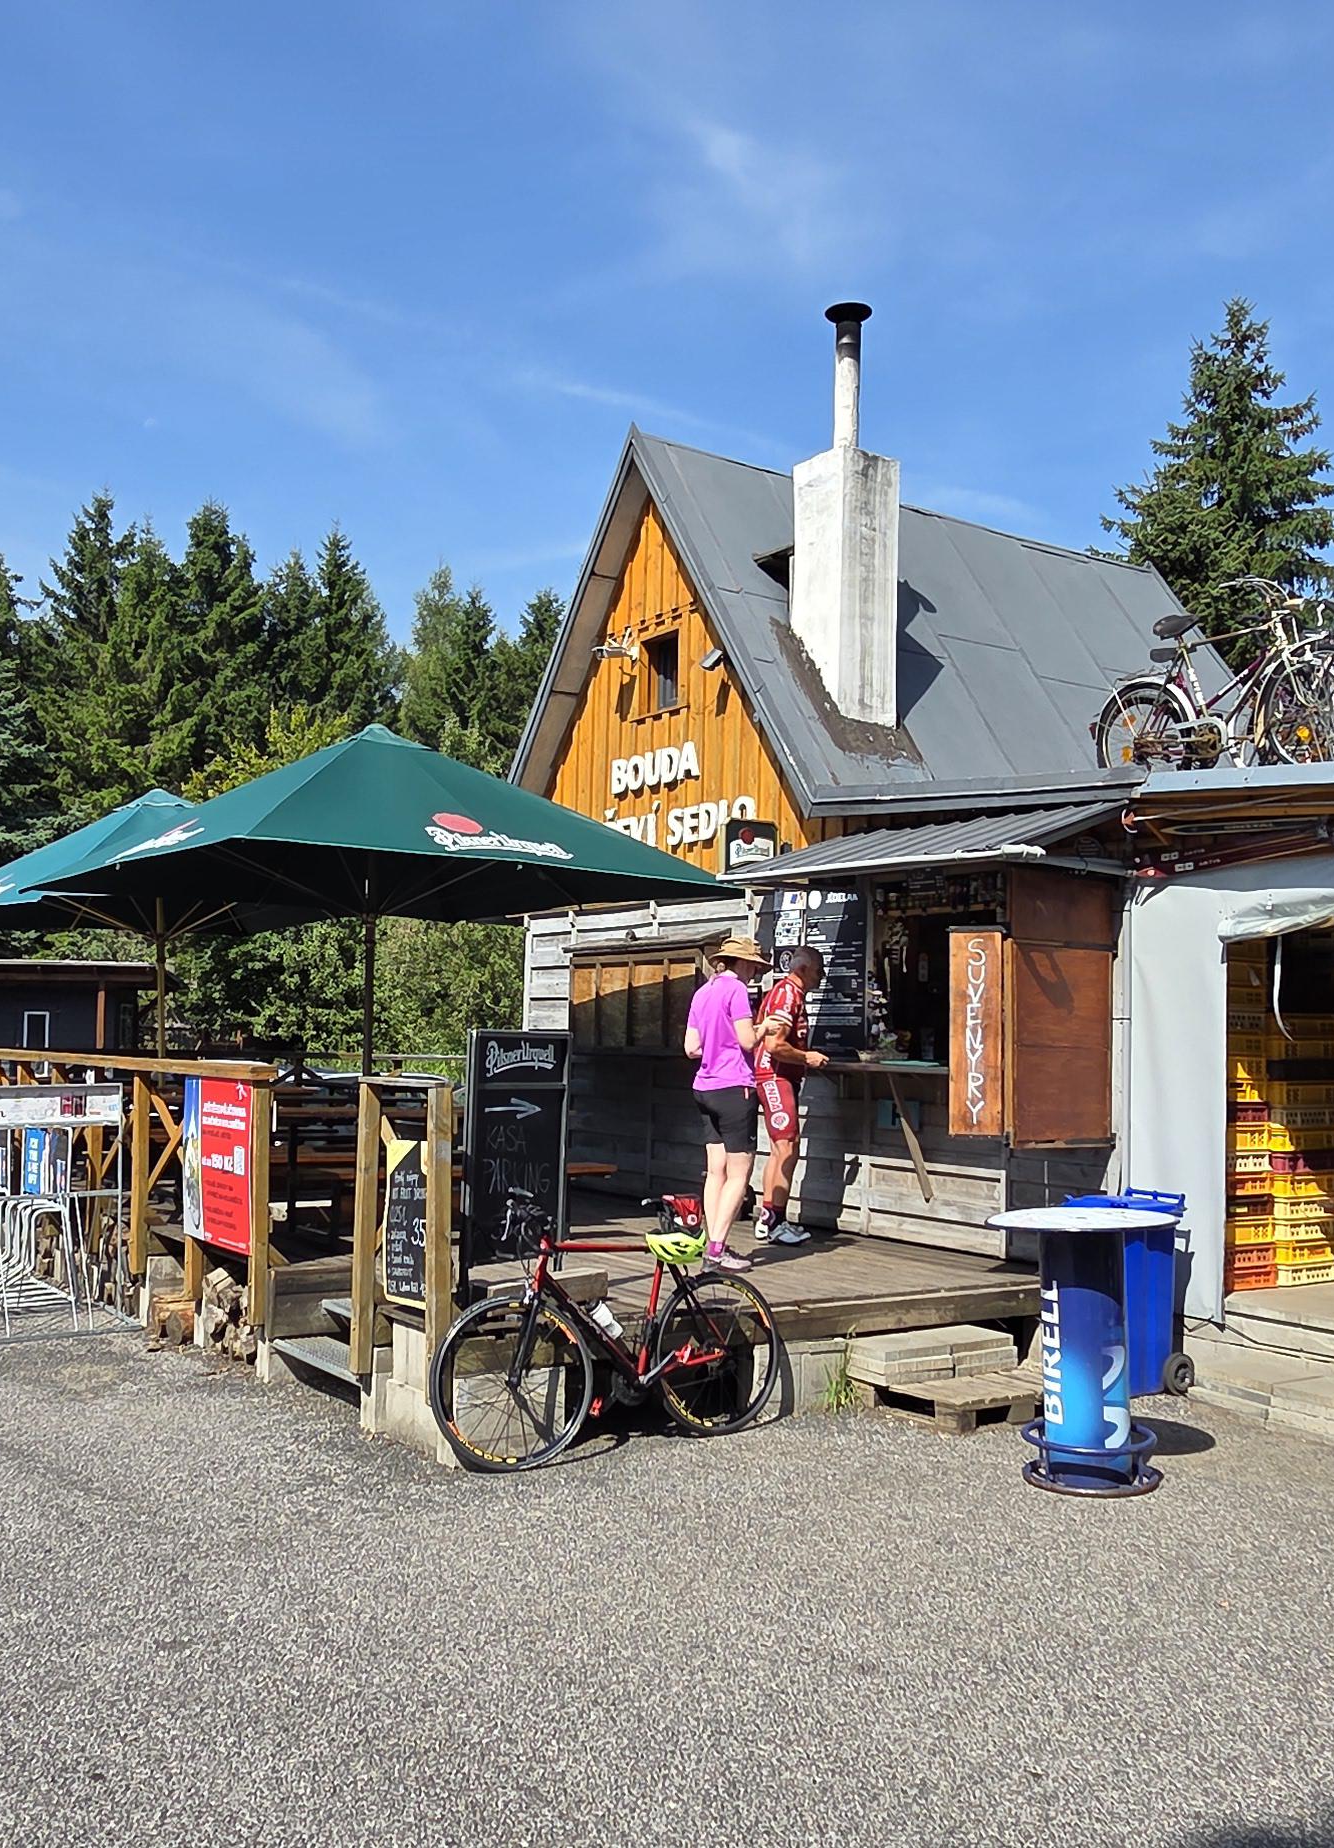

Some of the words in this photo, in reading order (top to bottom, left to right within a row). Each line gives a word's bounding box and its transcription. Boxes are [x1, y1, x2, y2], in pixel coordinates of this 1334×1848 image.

[611, 741, 700, 796] BOUDA
[603, 799, 662, 848] EVÍ
[485, 1040, 521, 1077] Pilsner
[520, 1040, 556, 1070] Urquell
[485, 1125, 527, 1153] KASA
[483, 1158, 551, 1194] PARKING
[411, 1217, 427, 1247] 35
[1040, 1280, 1064, 1425] BIRELL
